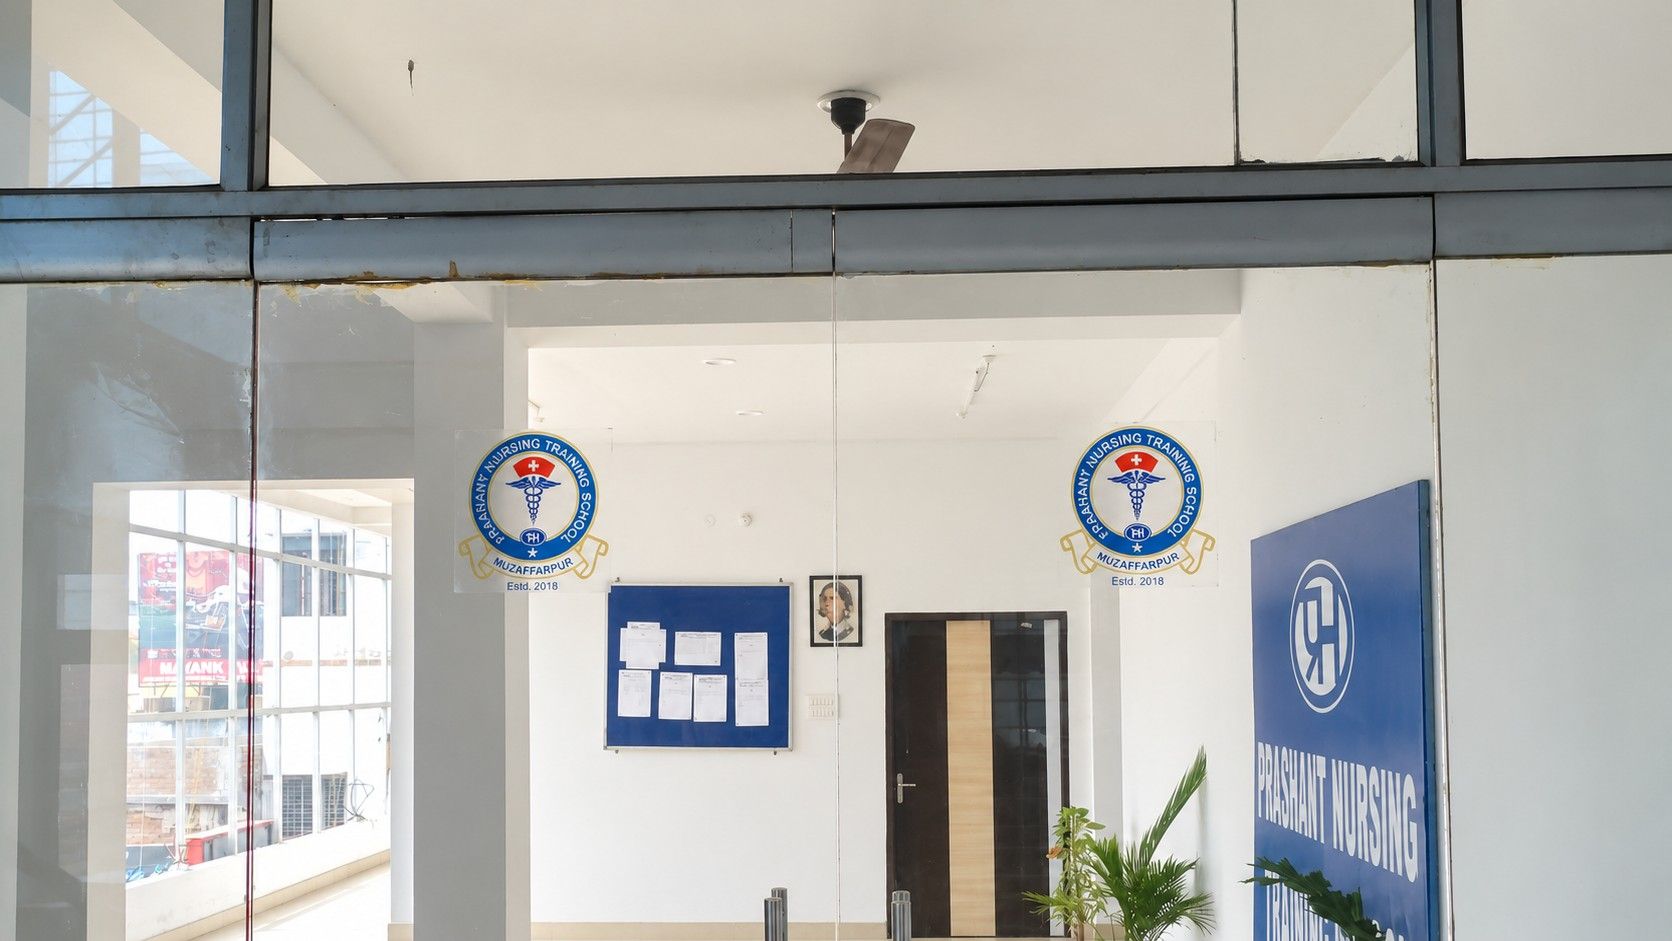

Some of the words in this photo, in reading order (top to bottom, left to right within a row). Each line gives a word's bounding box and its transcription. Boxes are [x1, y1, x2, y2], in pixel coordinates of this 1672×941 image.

[546, 440, 590, 487] TRAINING
[561, 492, 591, 543] SCHOOL
[1167, 487, 1197, 537] SCHOOL
[493, 557, 574, 575] MUZAFFARPUR
[1096, 552, 1179, 571] MUZAFFARPUR
[507, 582, 531, 591] Estd.
[534, 582, 558, 591] 2018
[1112, 576, 1136, 586] Estd.
[1140, 576, 1164, 586] 2018
[1257, 741, 1326, 843] PRASHANT
[1331, 759, 1418, 883] NURSING
